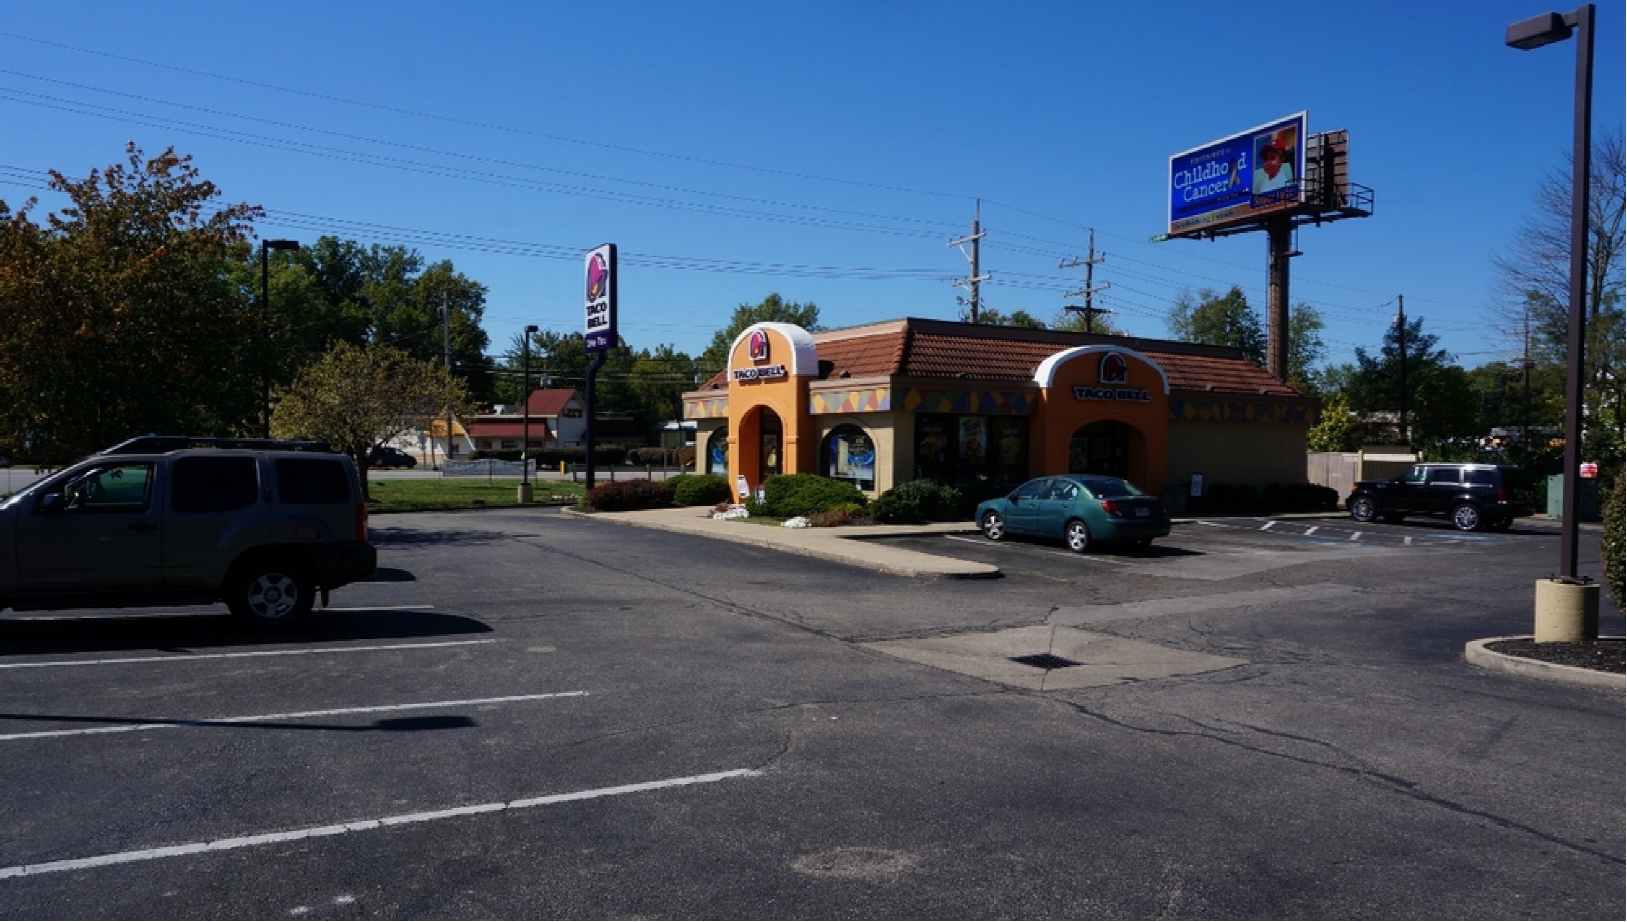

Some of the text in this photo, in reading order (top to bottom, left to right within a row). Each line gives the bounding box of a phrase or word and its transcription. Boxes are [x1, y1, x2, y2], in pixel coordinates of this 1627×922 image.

[1184, 179, 1229, 202] Cancer
[586, 301, 607, 316] TACO
[587, 315, 608, 329] BELL
[734, 366, 784, 380] TACO BELL
[1075, 387, 1150, 401] TACO BELL
